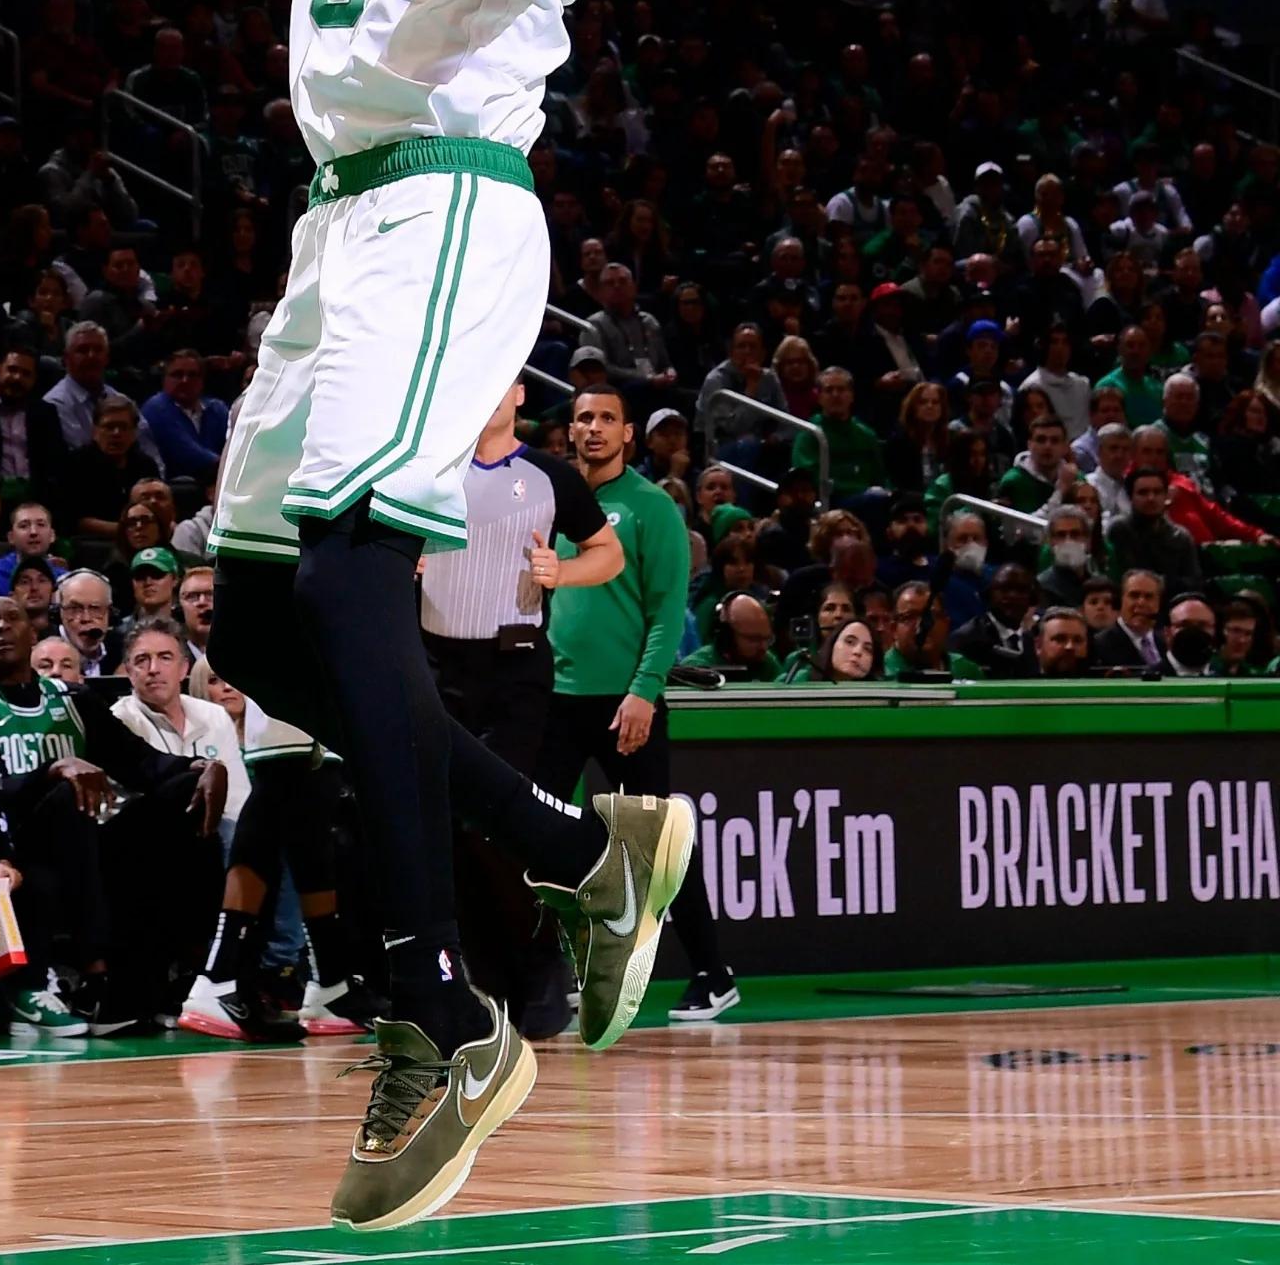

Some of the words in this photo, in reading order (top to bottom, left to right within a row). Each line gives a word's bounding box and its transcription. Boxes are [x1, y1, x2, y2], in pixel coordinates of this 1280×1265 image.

[668, 788, 897, 922] ick'Em
[958, 781, 1173, 910] BRACKET
[1187, 780, 1280, 902] CHA
